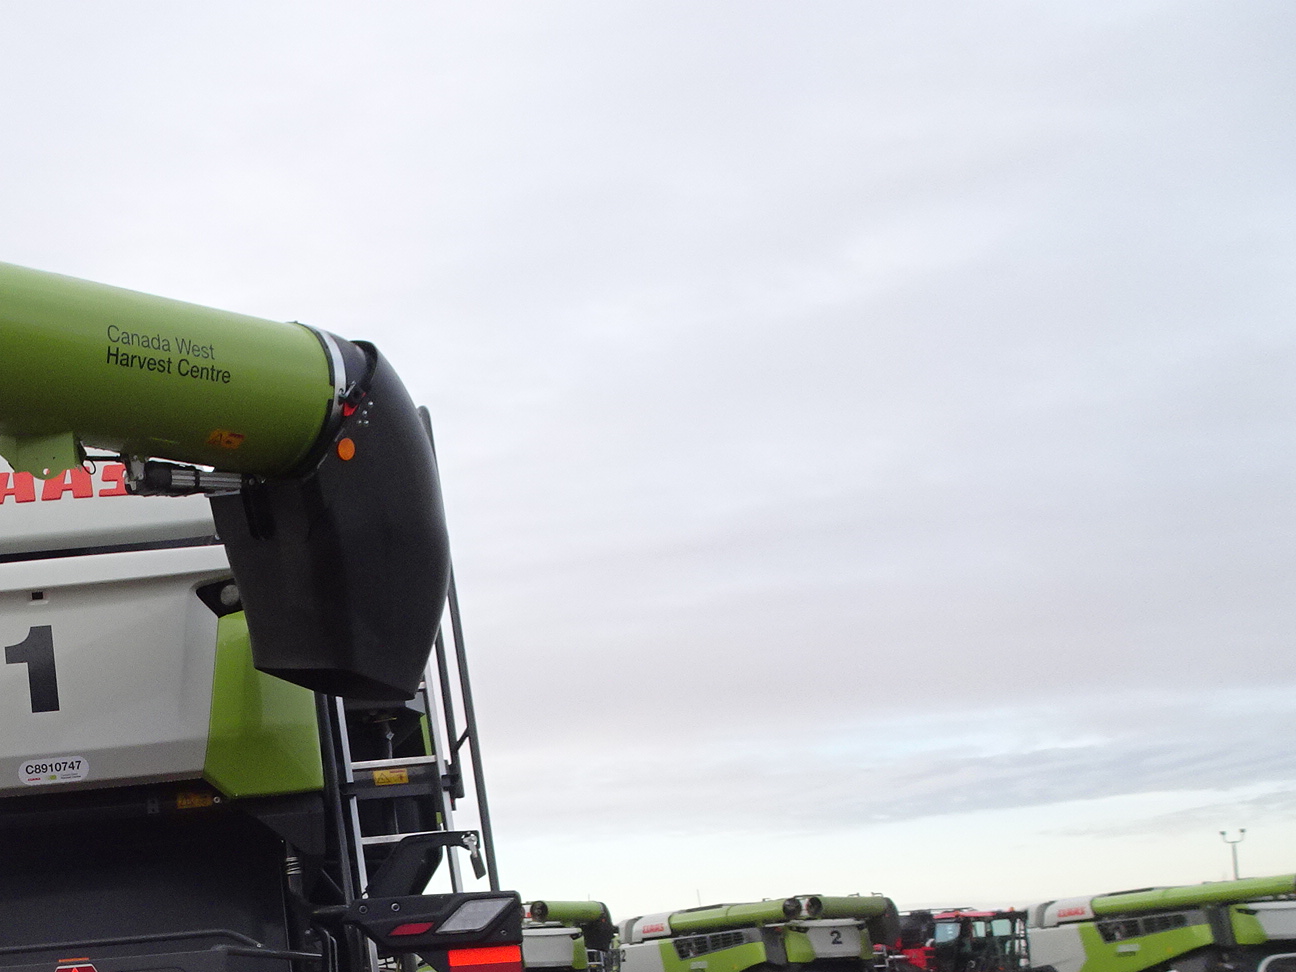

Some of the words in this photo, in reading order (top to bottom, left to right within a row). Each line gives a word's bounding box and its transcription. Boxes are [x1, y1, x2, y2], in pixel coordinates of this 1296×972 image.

[107, 325, 171, 352] Canada
[175, 337, 215, 360] West
[106, 346, 173, 374] Harvest
[177, 358, 231, 384] Centre
[4, 625, 60, 713] 1
[25, 760, 82, 775] C8910747
[830, 930, 843, 945] 2
